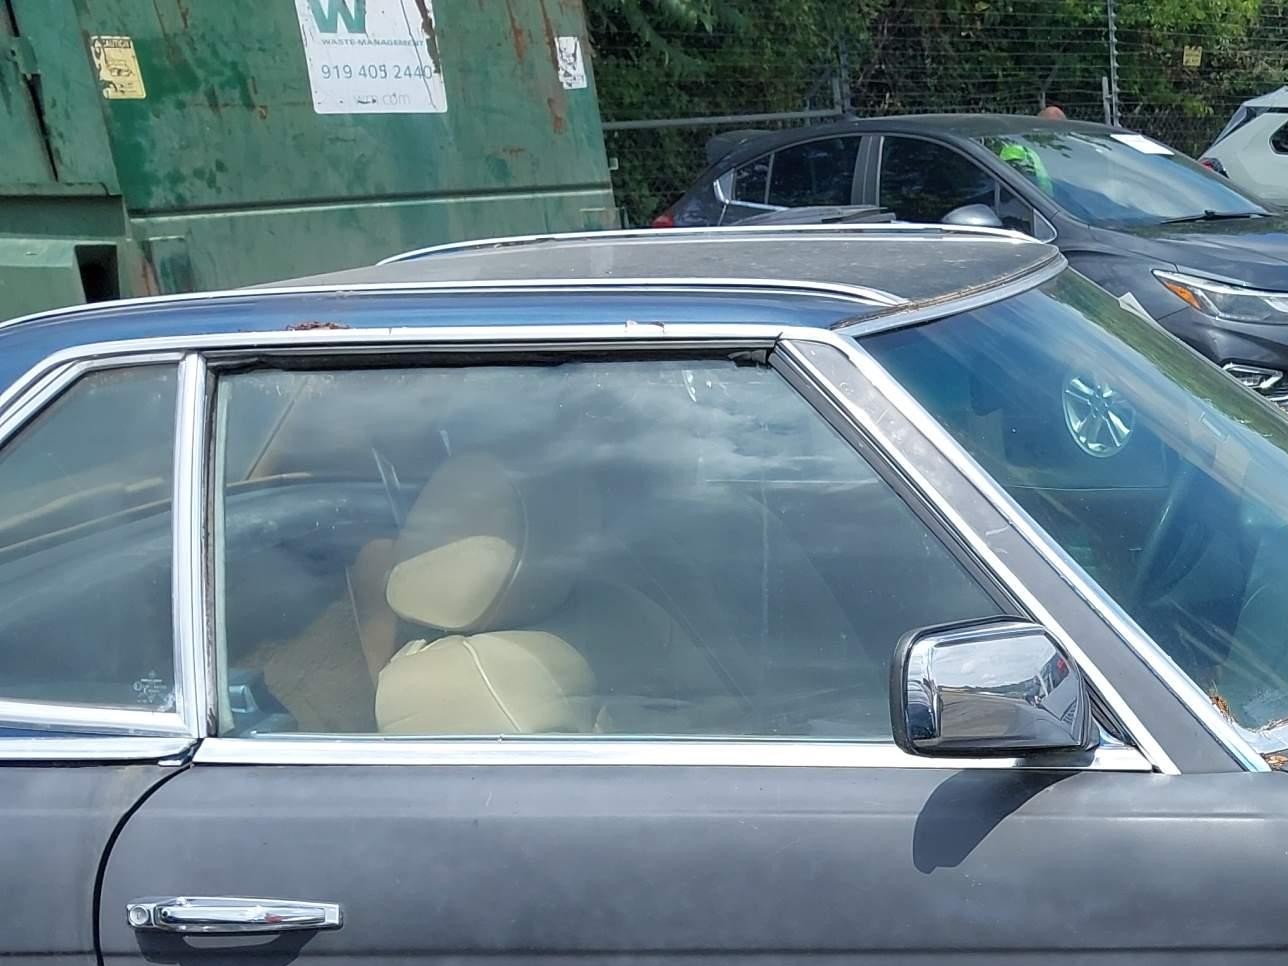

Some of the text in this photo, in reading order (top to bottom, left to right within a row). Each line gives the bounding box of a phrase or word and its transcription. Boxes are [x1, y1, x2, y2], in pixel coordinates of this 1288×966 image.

[357, 38, 425, 47] MANAGEMENT
[321, 64, 353, 79] 919
[393, 64, 433, 79] 2440
